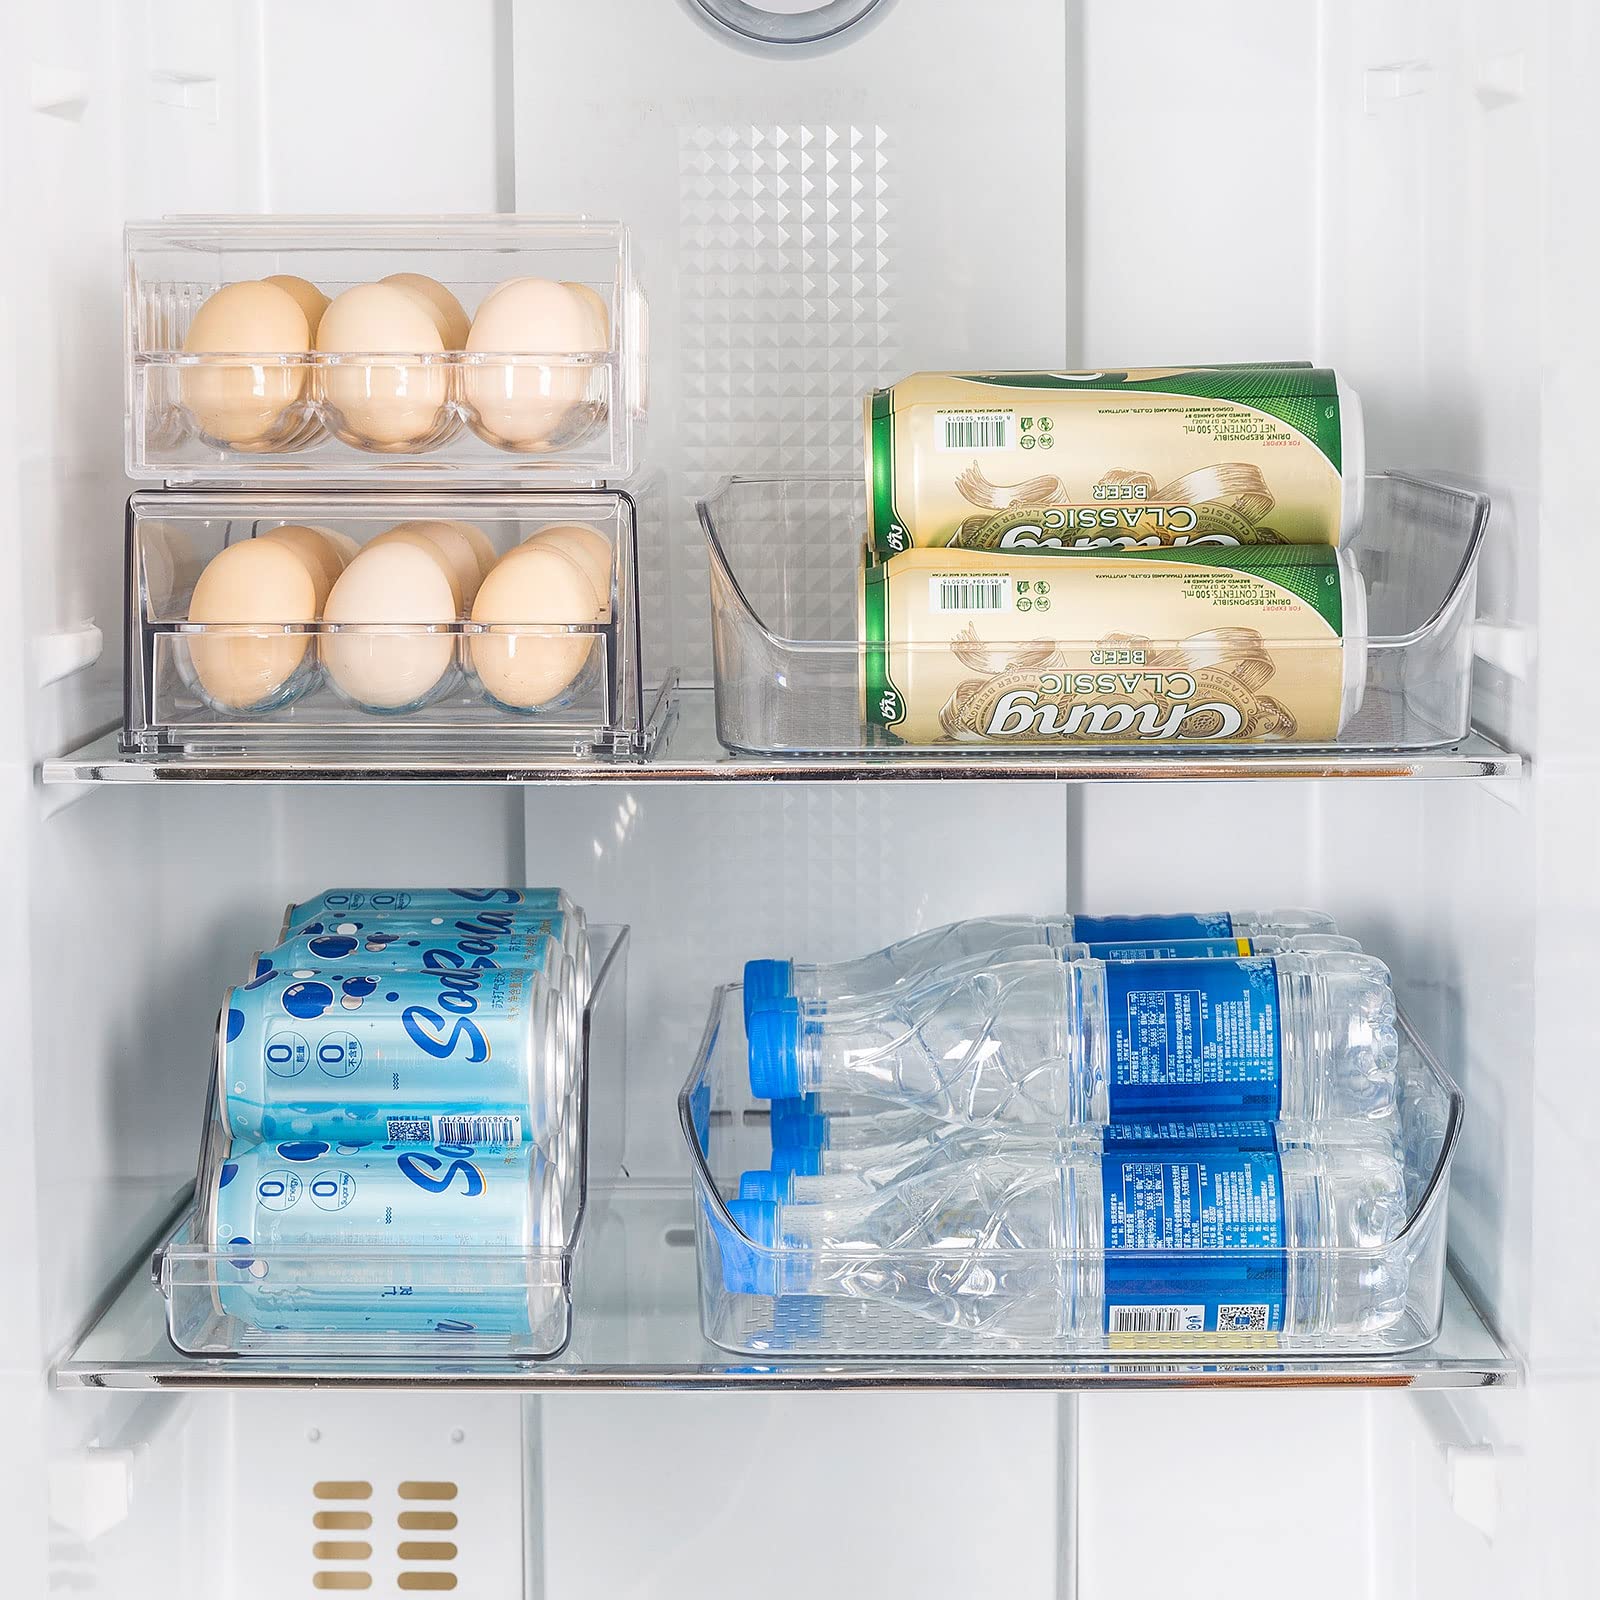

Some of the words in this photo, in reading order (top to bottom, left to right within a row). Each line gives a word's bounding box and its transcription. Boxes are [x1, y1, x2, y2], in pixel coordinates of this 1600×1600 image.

[1182, 425, 1196, 435] mL
[1196, 425, 1211, 434] 500
[1211, 424, 1258, 434] CONTENTS:
[1259, 424, 1276, 433] NET
[1093, 483, 1149, 500] BEER
[1001, 510, 1040, 524] LAGER
[1043, 506, 1199, 532] CLASSIC
[1202, 507, 1250, 536] CLASSIC
[1181, 590, 1195, 599] mL
[1195, 590, 1211, 599] 500
[1211, 590, 1258, 599] CONTENTS:
[1259, 590, 1276, 599] NET
[1089, 649, 1146, 666] BEER
[997, 675, 1037, 689] LAGER
[1039, 672, 1197, 700] CLASSIC
[1201, 673, 1250, 704] CLASSIC
[973, 687, 996, 712] BEER
[985, 690, 1243, 741] Chang
[266, 1045, 292, 1063] 0
[318, 1045, 345, 1063] 0
[348, 1041, 358, 1068] 不含糖
[258, 1181, 285, 1197] 0
[287, 1177, 299, 1202] Energy
[311, 1181, 338, 1197] 0
